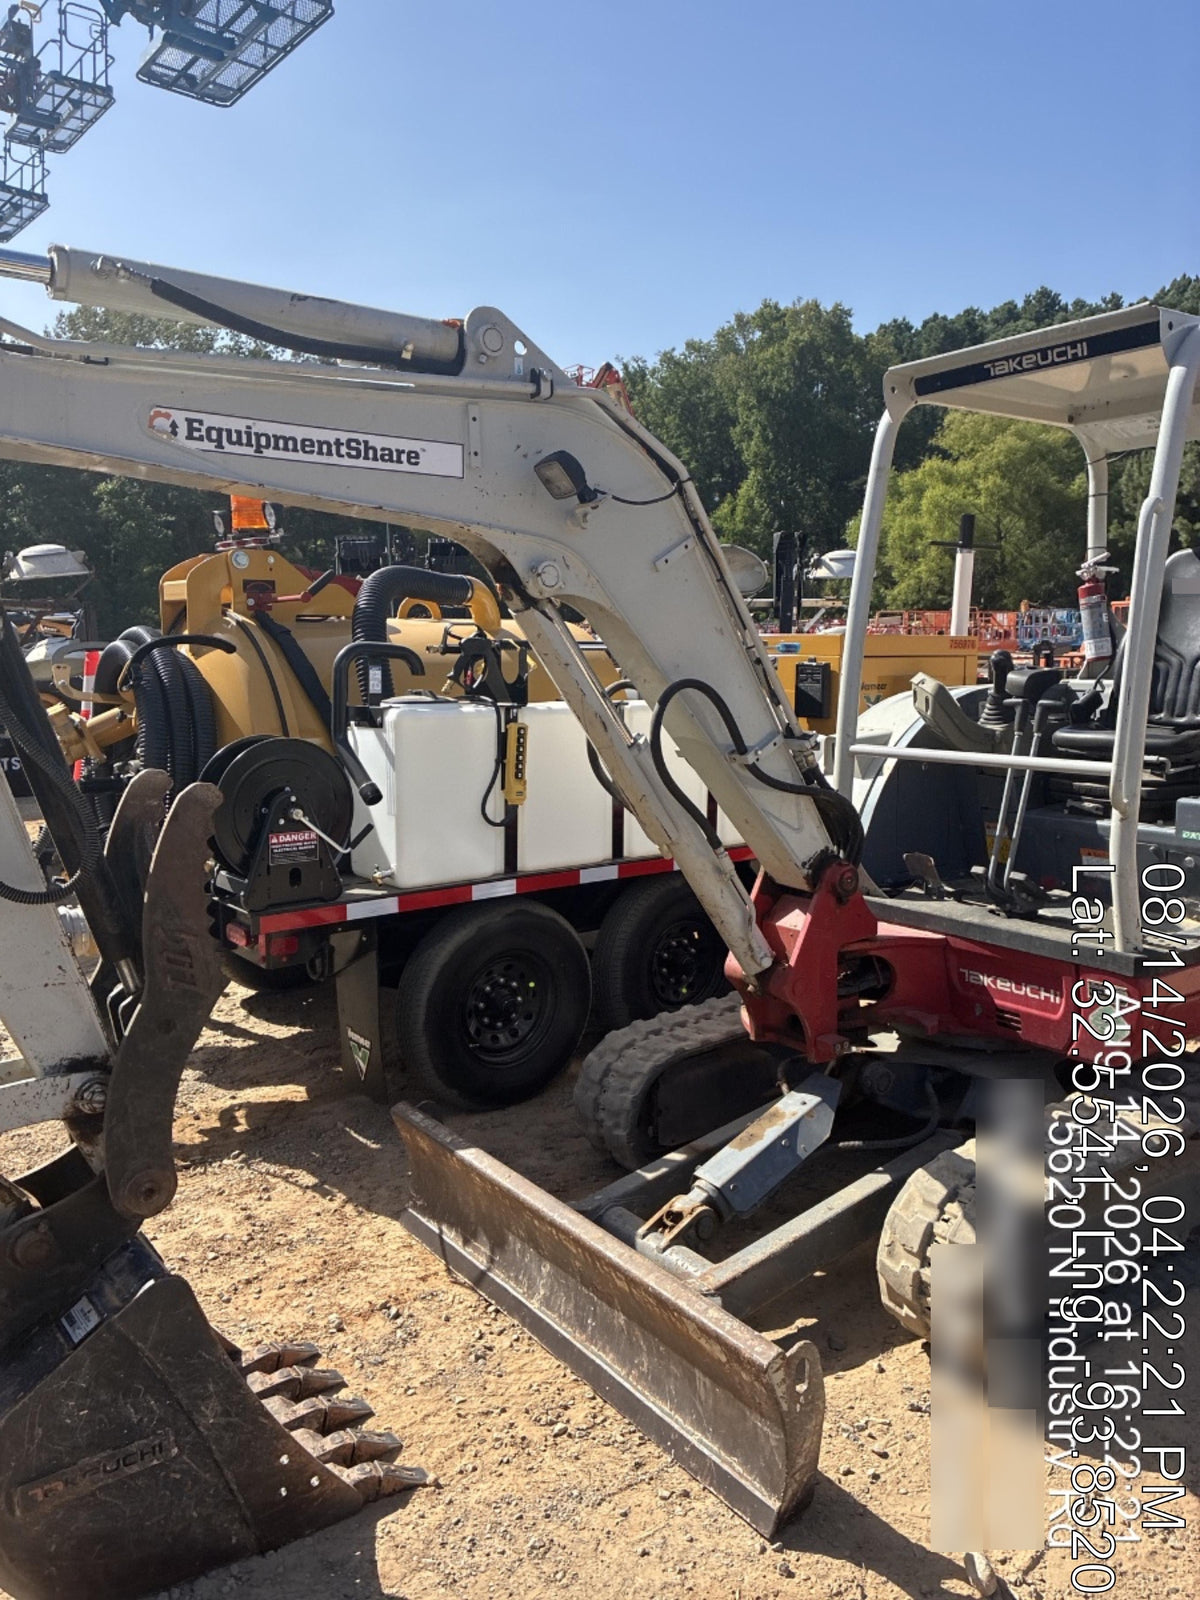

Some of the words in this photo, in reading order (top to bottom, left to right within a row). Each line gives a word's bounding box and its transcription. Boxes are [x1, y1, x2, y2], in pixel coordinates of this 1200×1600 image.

[984, 342, 1088, 376] TAKEUCHI
[184, 416, 421, 467] EquipmentShare
[279, 831, 317, 843] DANGER
[959, 967, 1061, 1004] TAKEUCHI
